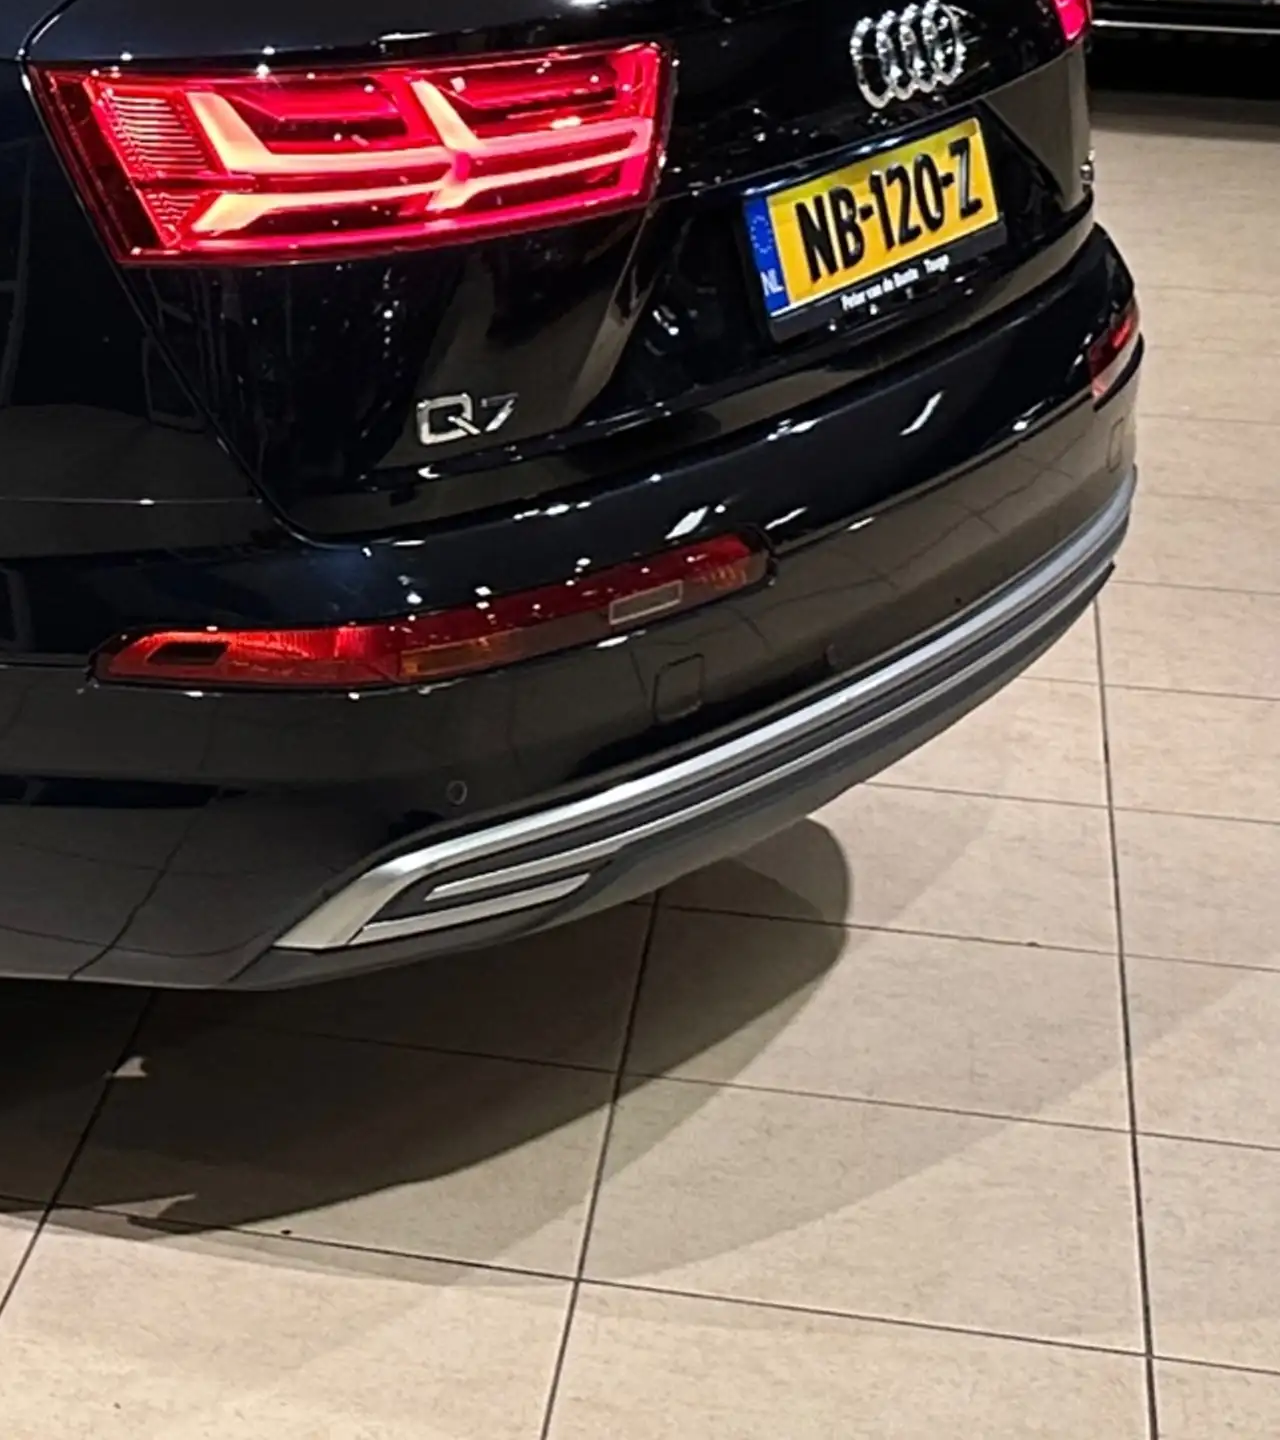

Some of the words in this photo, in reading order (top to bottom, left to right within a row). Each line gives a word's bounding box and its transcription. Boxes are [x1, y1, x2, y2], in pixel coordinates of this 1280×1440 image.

[794, 137, 983, 284] NB-120-Z
[760, 268, 784, 297] NL
[416, 392, 520, 445] Q7
